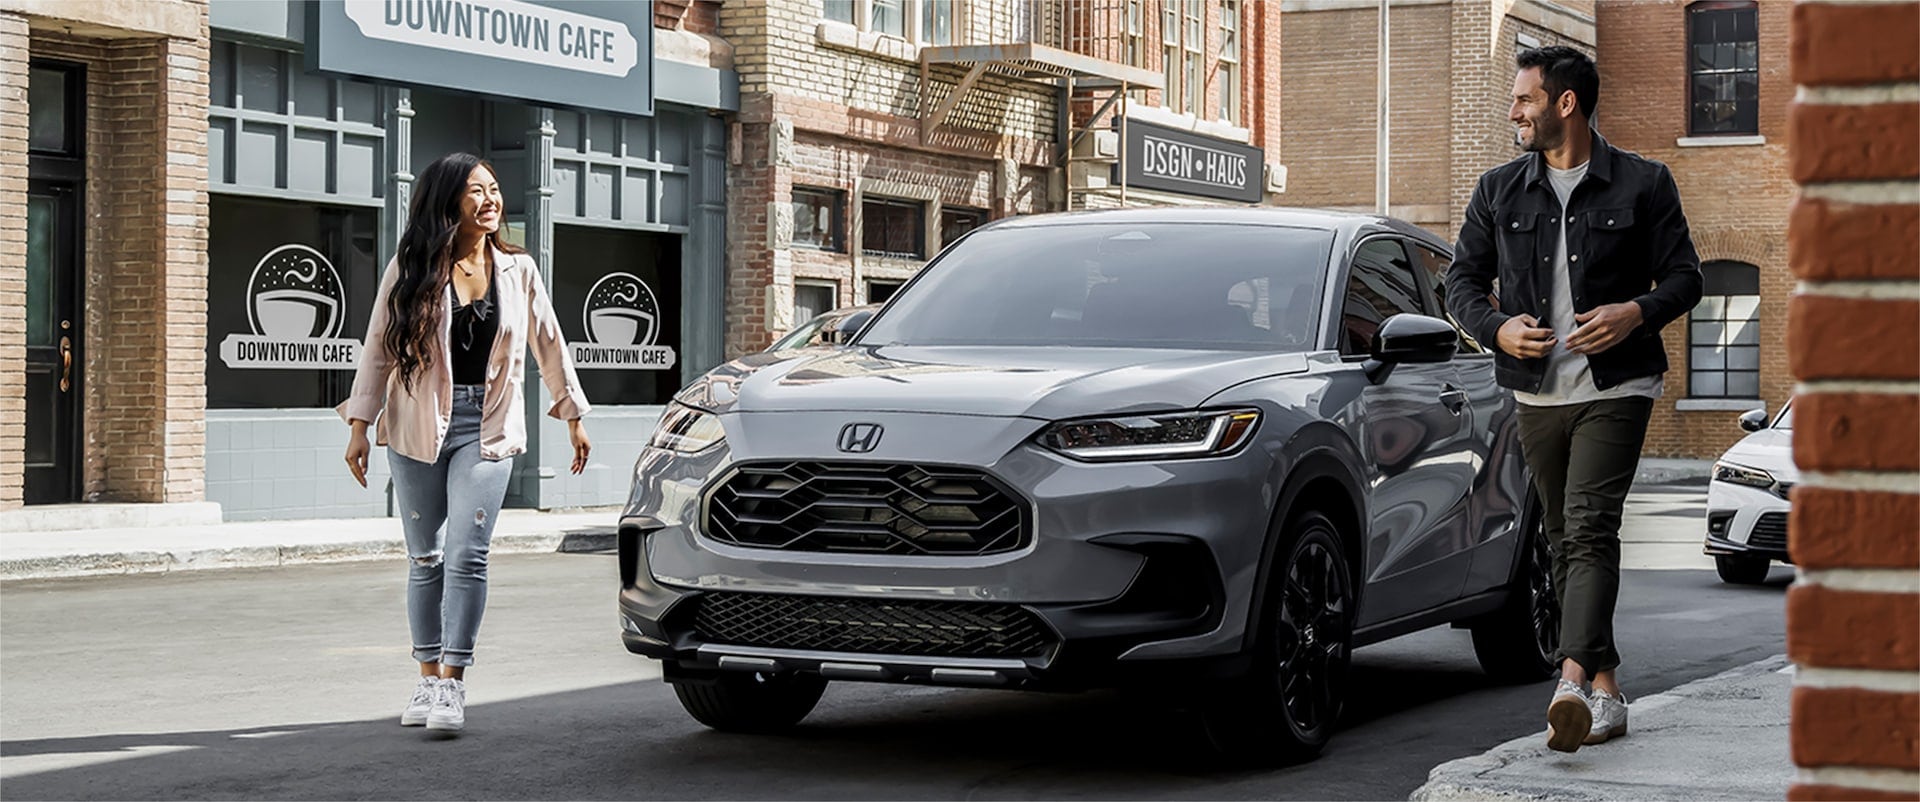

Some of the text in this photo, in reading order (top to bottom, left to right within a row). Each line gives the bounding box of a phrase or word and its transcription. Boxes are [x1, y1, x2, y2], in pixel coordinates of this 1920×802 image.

[385, 0, 615, 64] DOWNTOWN CAFE
[1143, 139, 1247, 186] DSGN HAUS
[237, 341, 353, 363] DOWNTOWN CAFE
[576, 347, 666, 365] DOWNTOWN CAFE
